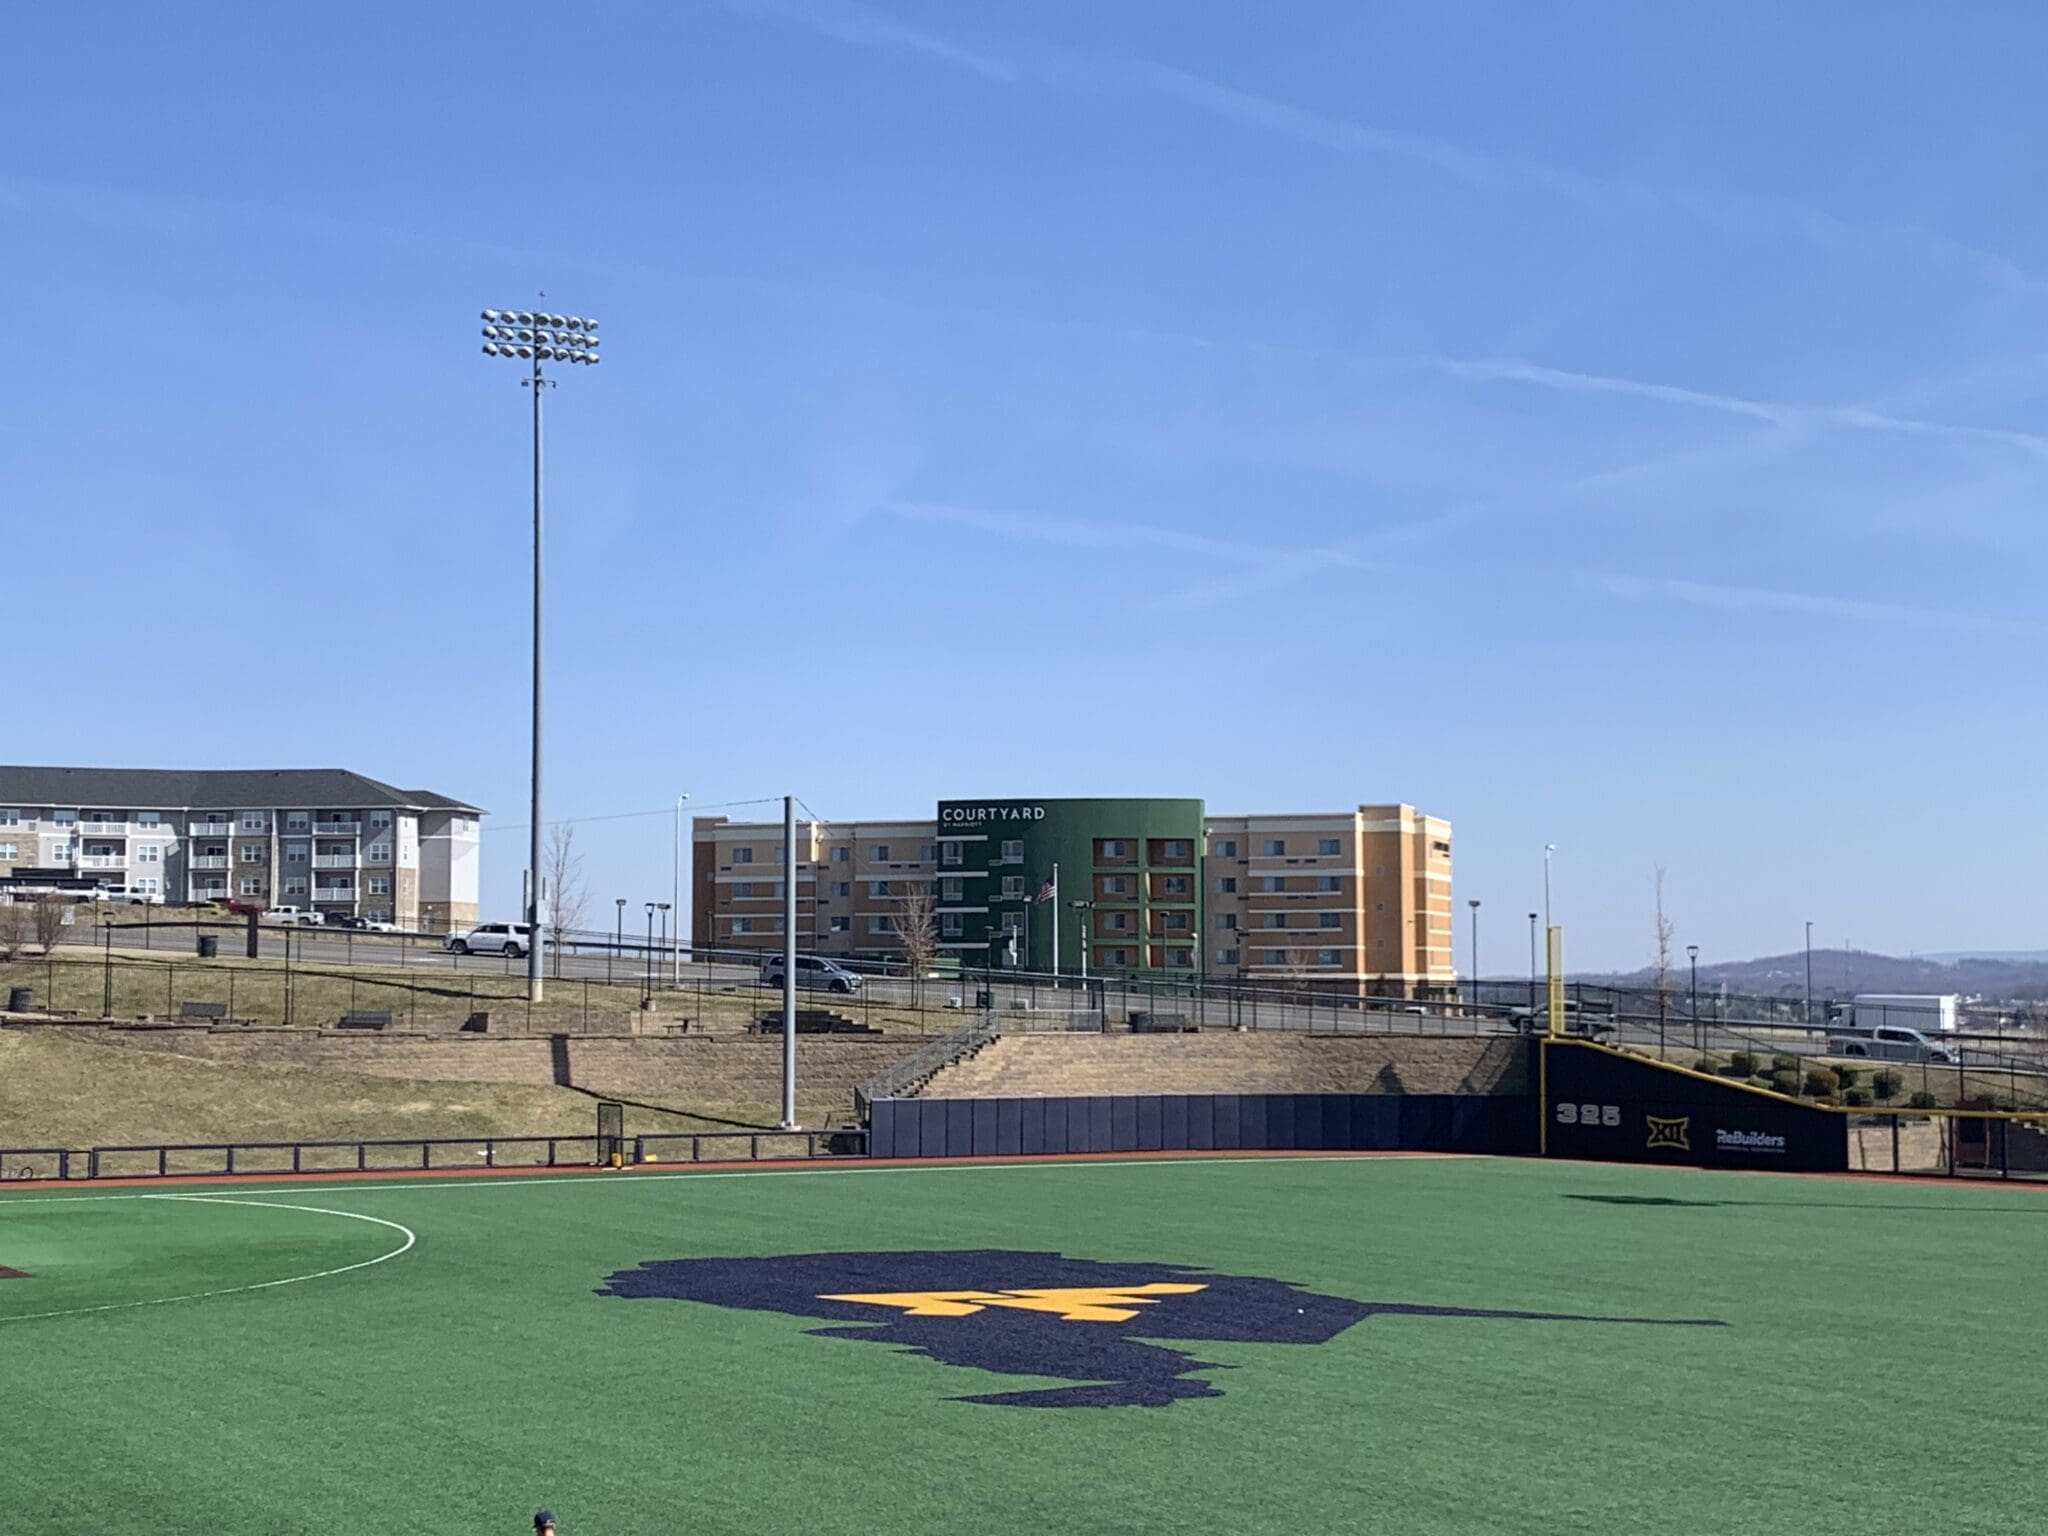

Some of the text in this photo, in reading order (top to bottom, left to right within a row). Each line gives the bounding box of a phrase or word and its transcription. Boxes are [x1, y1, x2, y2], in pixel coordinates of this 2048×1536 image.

[943, 807, 1045, 821] COURTYARD
[1556, 1102, 1620, 1126] 325
[1716, 1129, 1785, 1147] ReBuilders
